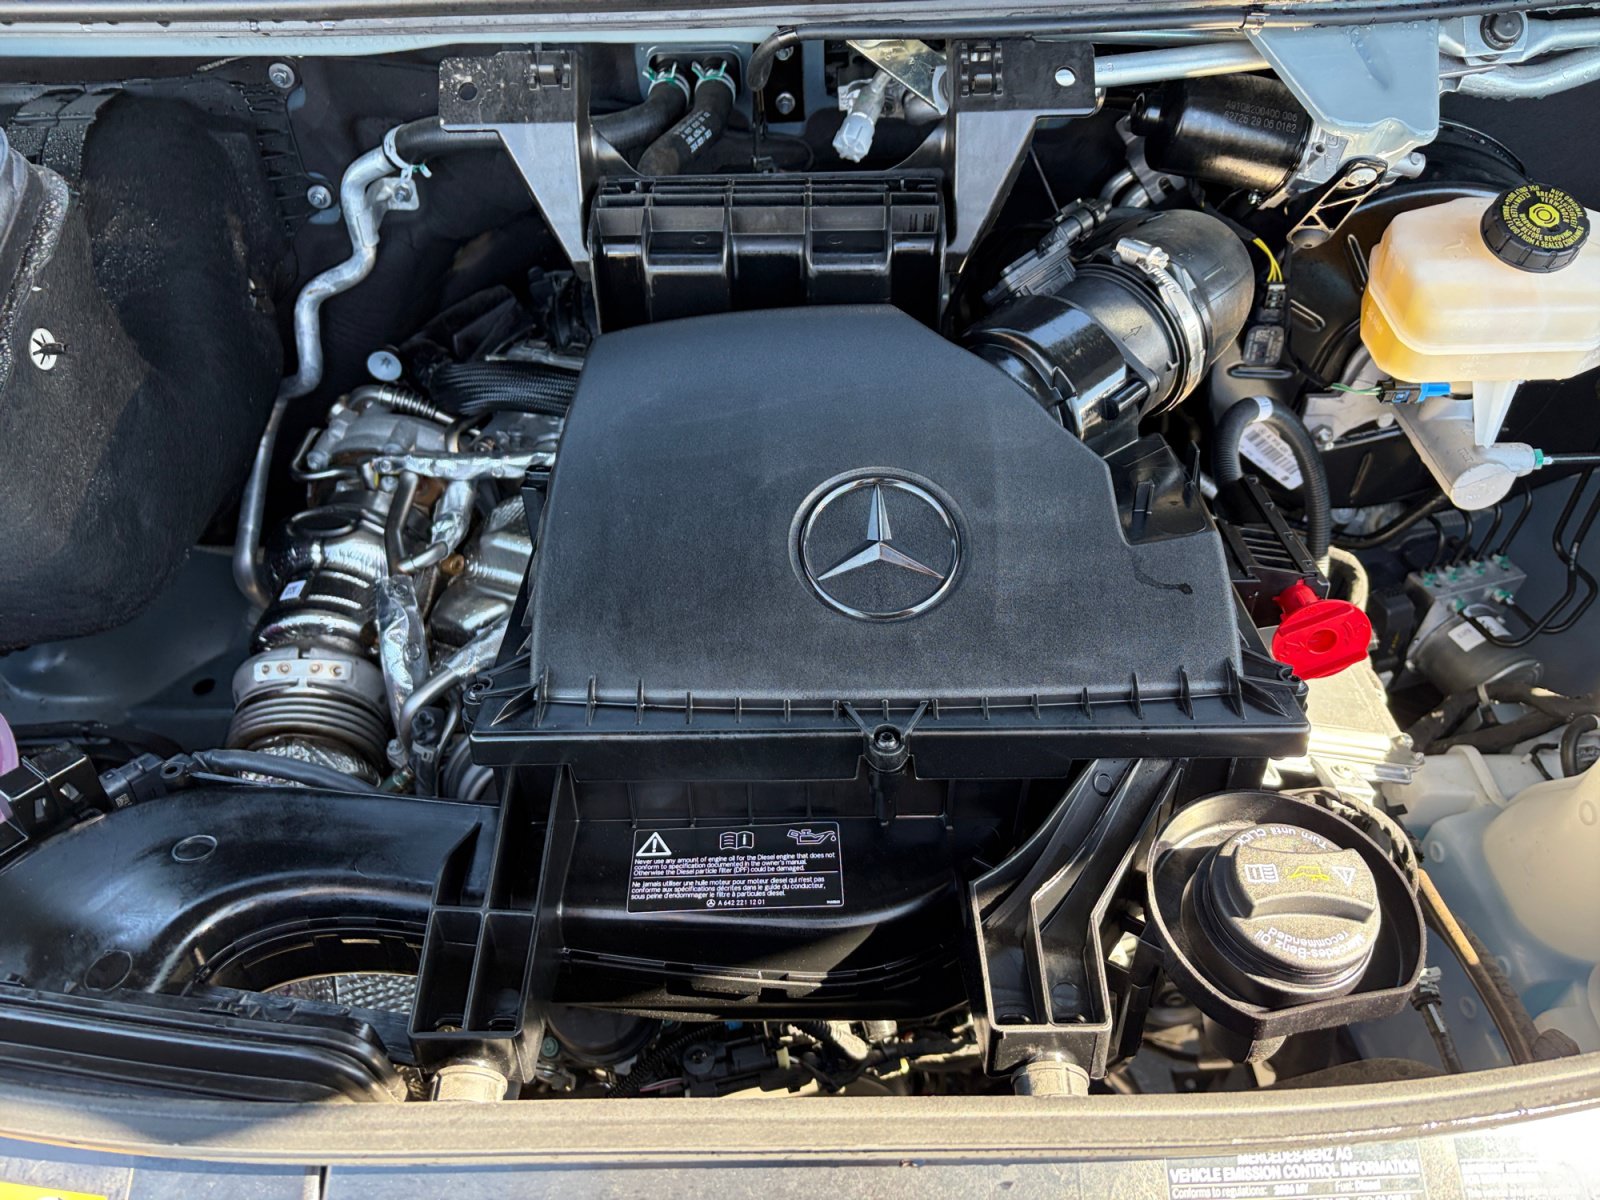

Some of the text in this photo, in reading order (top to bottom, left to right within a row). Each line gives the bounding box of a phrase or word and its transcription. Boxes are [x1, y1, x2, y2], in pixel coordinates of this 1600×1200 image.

[1234, 826, 1327, 849] Turn until CLICK
[1254, 930, 1365, 960] Mercedes-Benz Oil
[1269, 927, 1348, 947] recommended
[1336, 1147, 1352, 1161] AG
[1170, 1159, 1419, 1183] VEHICLE EMISSION CONTROL INFORMATION
[1172, 1187, 1211, 1199] Conforms
[1212, 1187, 1221, 1197] to
[1222, 1185, 1267, 1198] regulations:
